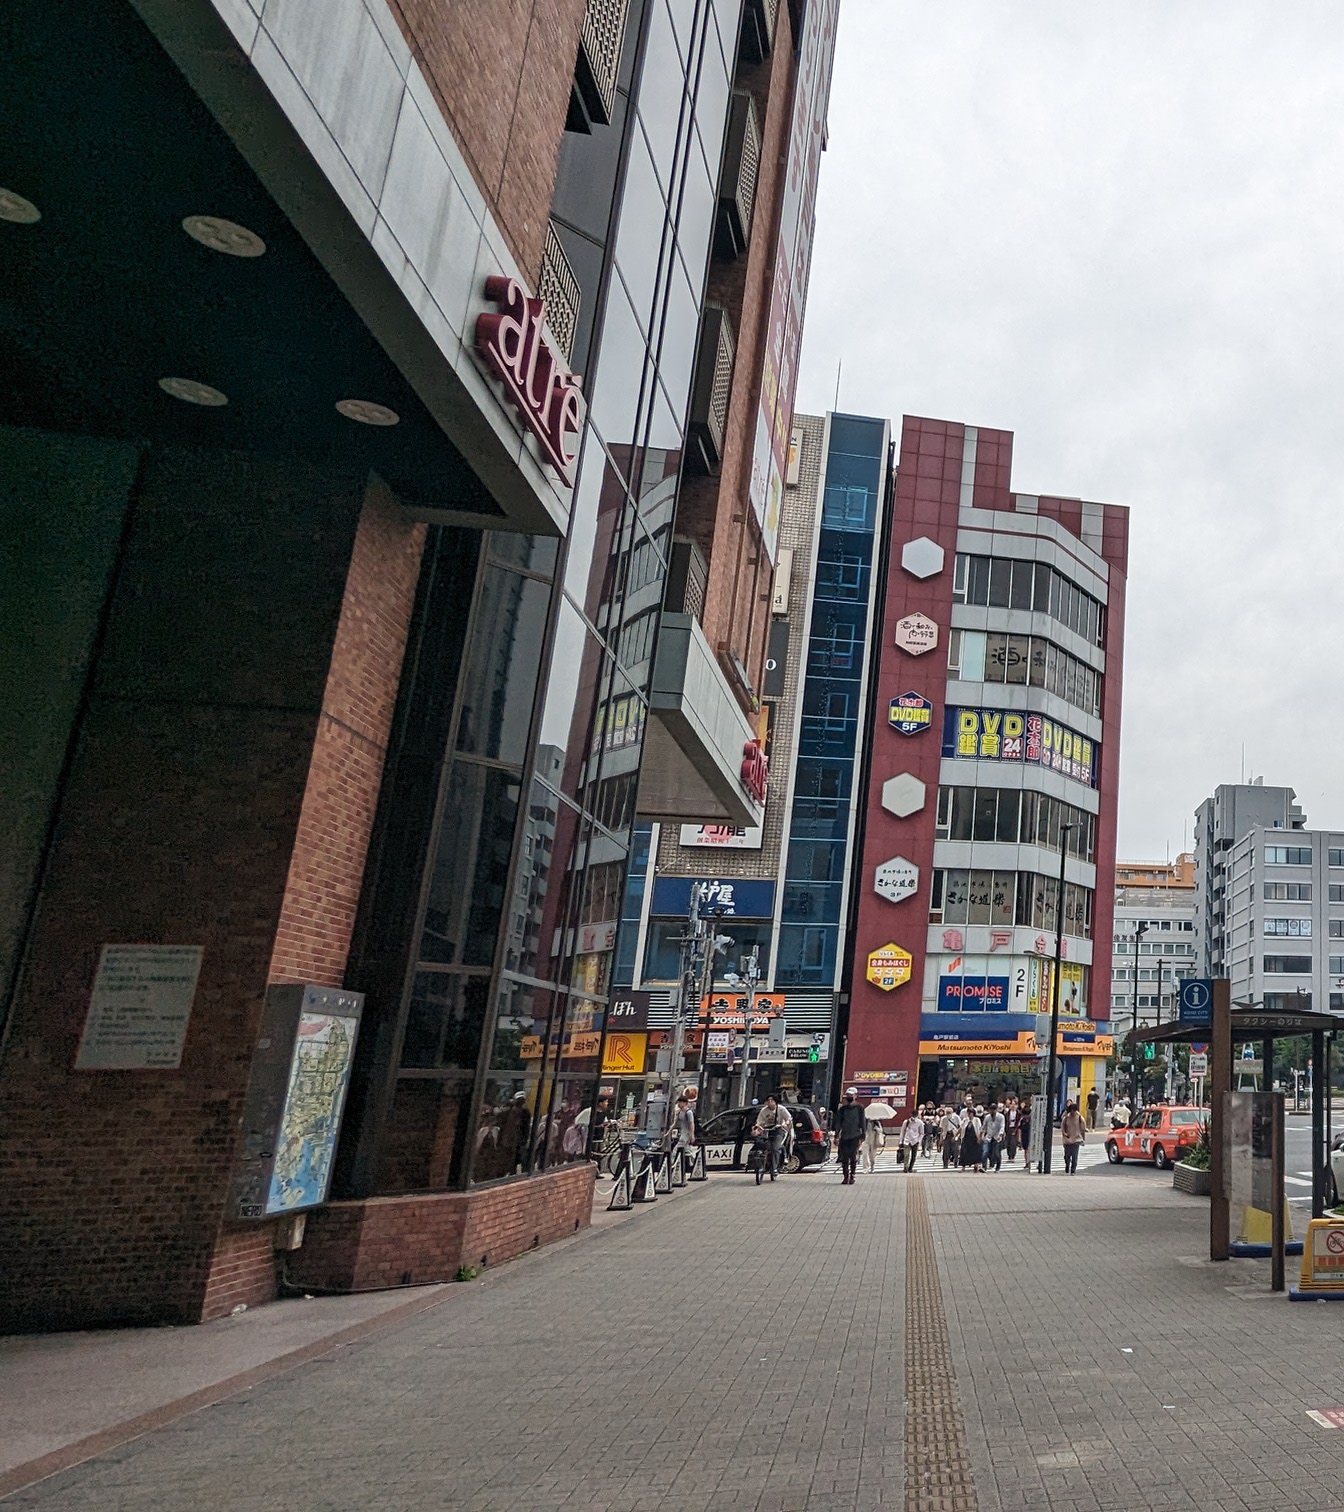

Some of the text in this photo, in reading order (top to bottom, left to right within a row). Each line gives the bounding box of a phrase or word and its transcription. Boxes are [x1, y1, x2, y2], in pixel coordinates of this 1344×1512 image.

[901, 722, 918, 731] 5F
[958, 710, 1024, 738] DVD
[956, 733, 1001, 757] 鑑賞
[1004, 738, 1021, 753] 24
[945, 985, 1003, 997] PROMISE
[706, 1149, 732, 1159] TAXI
